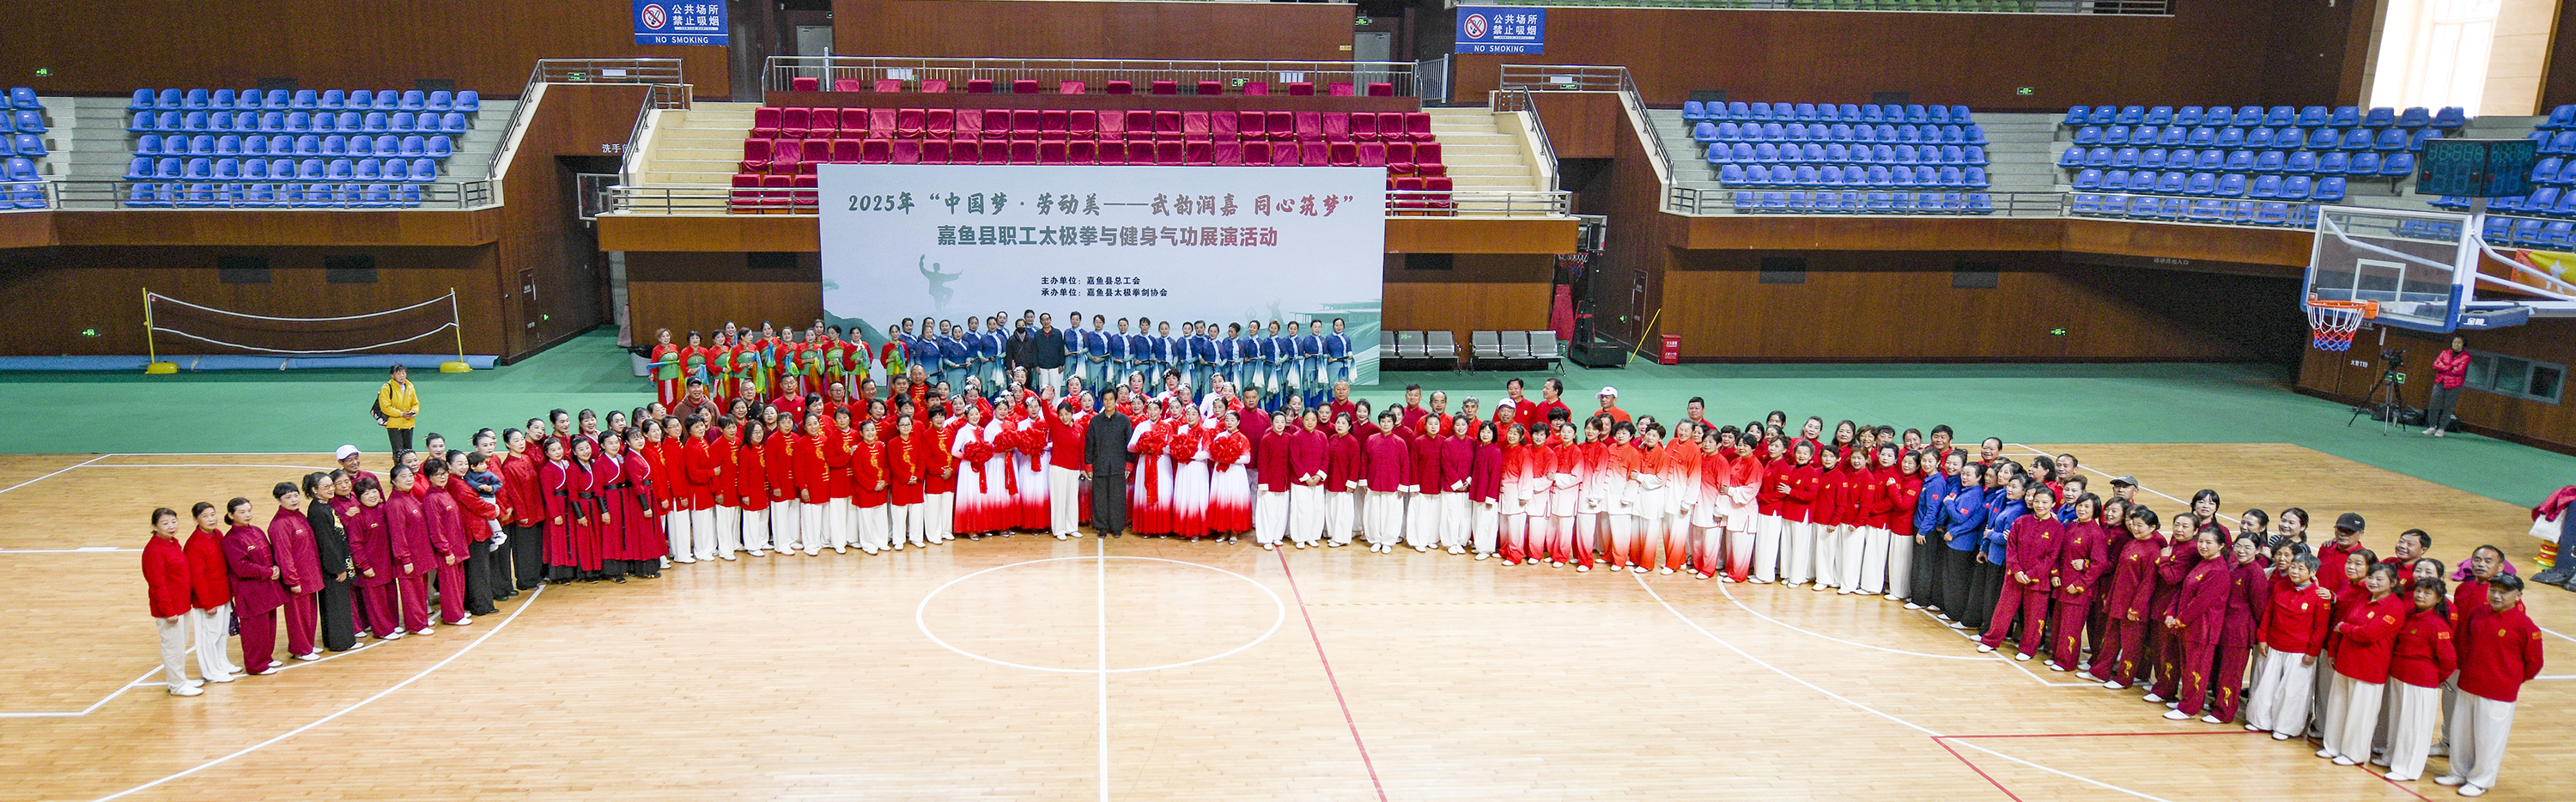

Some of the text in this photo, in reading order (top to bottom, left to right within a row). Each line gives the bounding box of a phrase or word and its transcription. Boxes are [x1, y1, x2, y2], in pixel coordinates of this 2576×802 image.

[672, 4, 719, 15] 公共场所
[672, 15, 720, 26] 禁止吸烟
[1493, 14, 1537, 25] 公共场所
[1492, 25, 1537, 35] 禁止吸烟
[937, 225, 1278, 246] 嘉鱼县职工太极拳与健身气功展演活动
